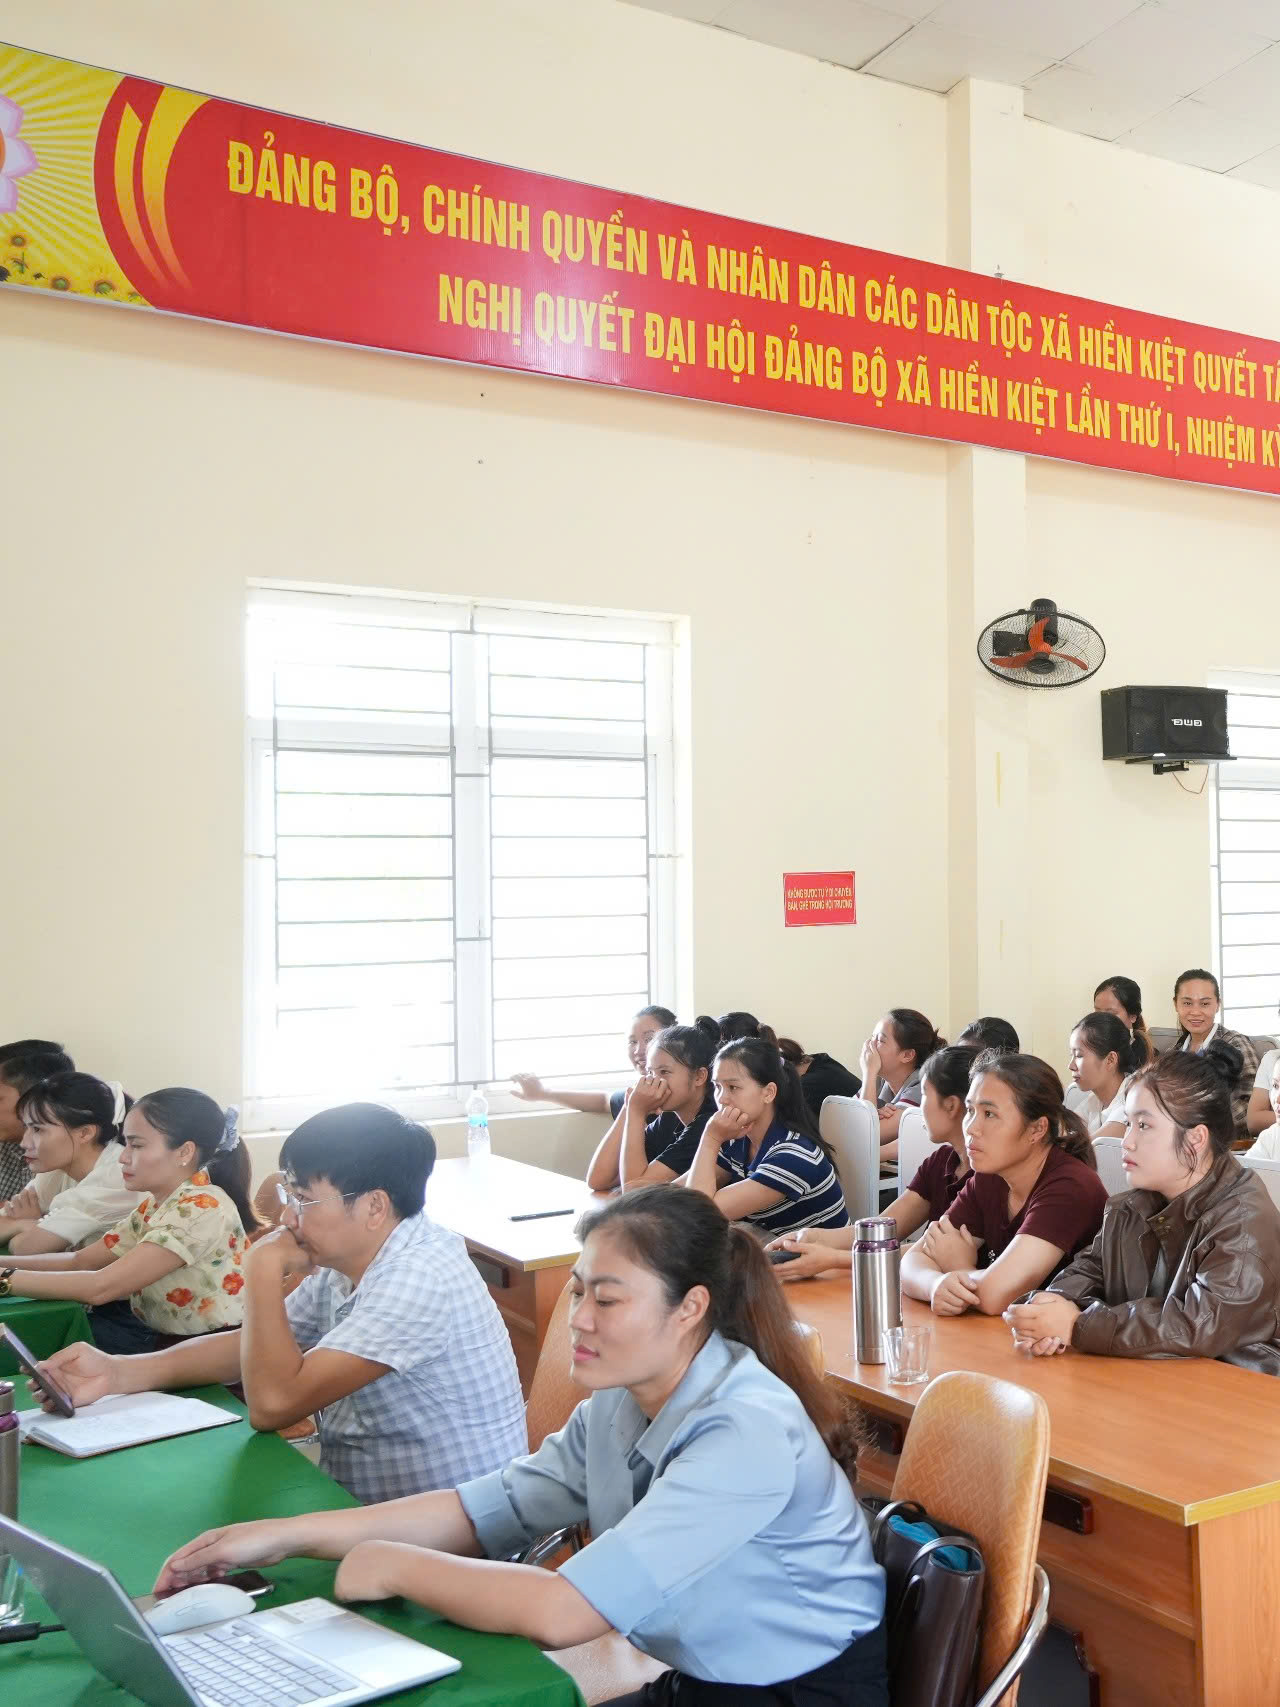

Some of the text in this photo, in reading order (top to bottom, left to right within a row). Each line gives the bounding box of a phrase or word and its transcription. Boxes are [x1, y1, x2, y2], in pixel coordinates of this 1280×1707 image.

[227, 131, 336, 213] ĐẢNG
[351, 164, 410, 236] BỘ,
[423, 184, 530, 252] CHÍNH
[542, 210, 648, 275] QUYỀN
[657, 229, 697, 285] VÀ
[707, 245, 789, 304] NHÂN
[798, 261, 856, 318] DÂN
[864, 275, 918, 330] CÁC
[926, 288, 979, 342] DÂN
[986, 300, 1032, 358] TỘC
[1039, 313, 1073, 362] XÃ
[1078, 320, 1133, 375] HIỀN
[1139, 336, 1187, 392] KIỆT
[1193, 348, 1257, 399] QUYẾT
[439, 274, 521, 346] NGHỊ
[534, 291, 635, 354] QUYẾT
[643, 312, 696, 373] ĐẠI
[706, 319, 756, 383] HỘI
[764, 325, 843, 391] ĐẢNG
[851, 346, 888, 408] BỘ
[895, 355, 932, 407] XÃ
[939, 360, 999, 418] HIỀN
[1006, 377, 1059, 436] KIỆT
[1065, 382, 1111, 439] LẦN
[1116, 401, 1162, 448] THỨ
[1166, 412, 1181, 456] I,
[1186, 415, 1256, 469] NHIỆM
